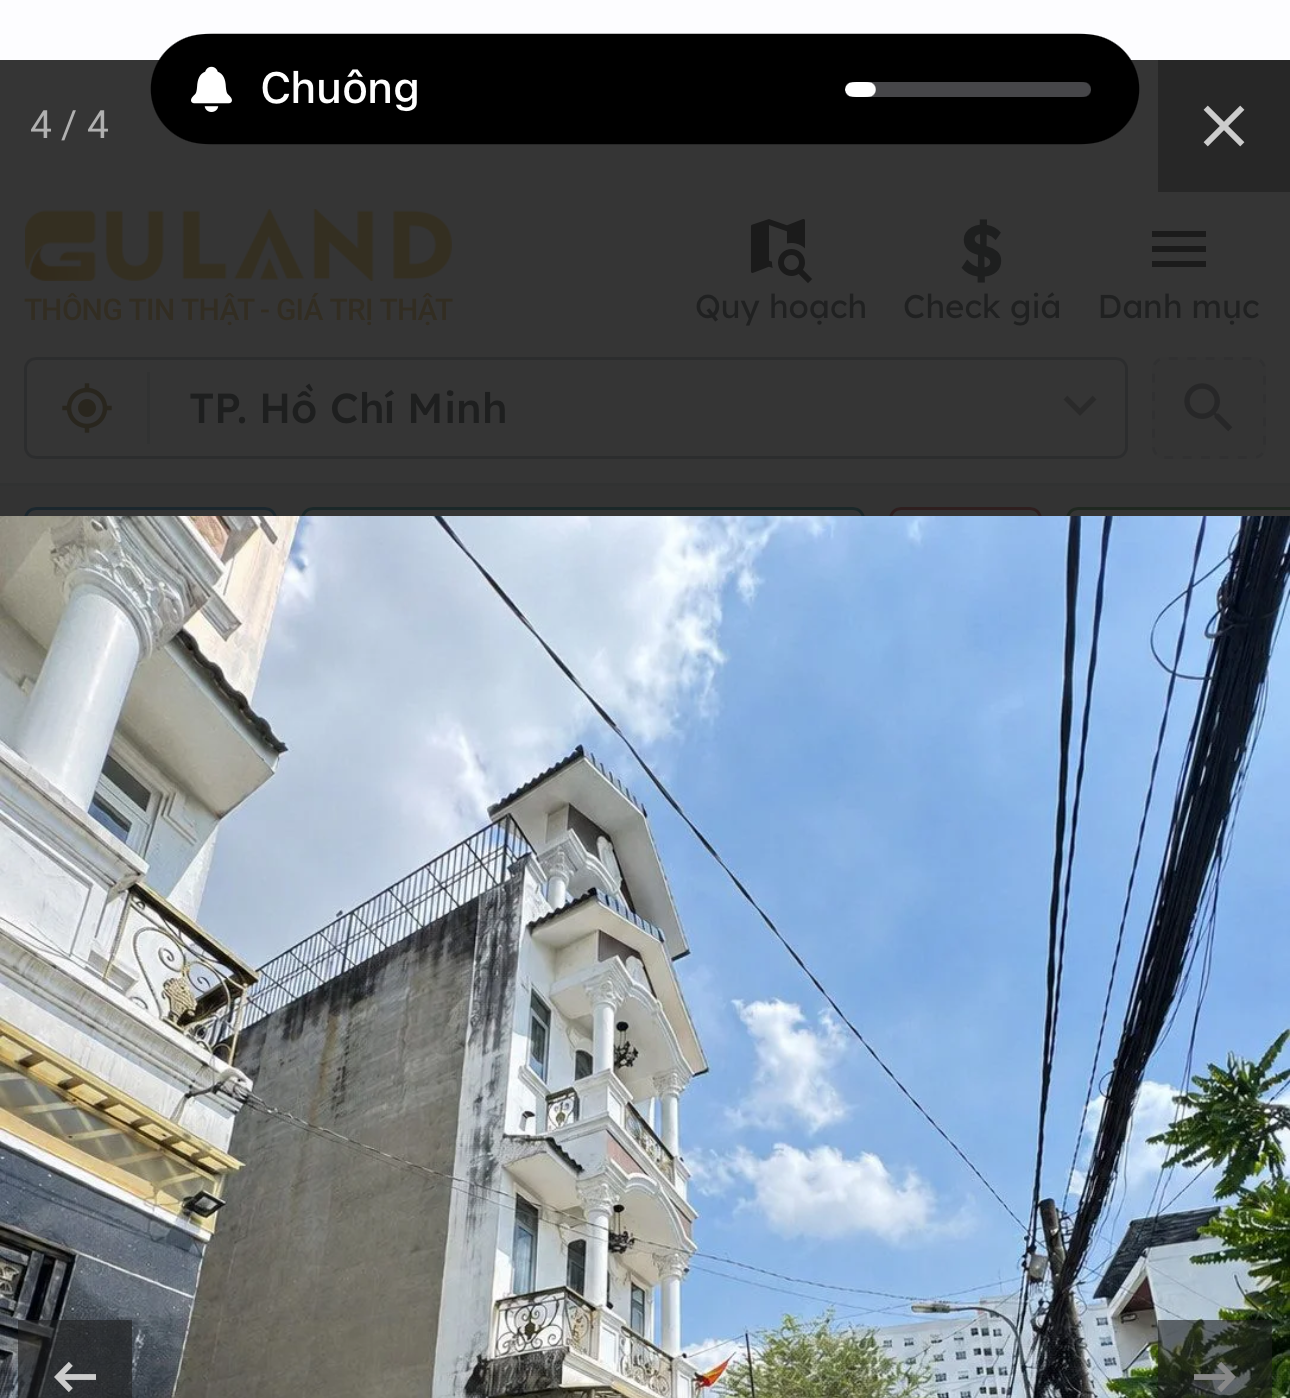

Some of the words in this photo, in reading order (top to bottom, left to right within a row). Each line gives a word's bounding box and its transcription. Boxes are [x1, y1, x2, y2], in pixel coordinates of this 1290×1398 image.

[262, 69, 417, 111] Chuông
[31, 110, 51, 138] 4
[61, 110, 76, 141] /
[88, 110, 108, 138] 4
[25, 209, 452, 281] GULAND
[24, 293, 121, 320] THÔNG
[129, 298, 173, 320] TIN
[181, 293, 255, 325] THẬT
[277, 293, 323, 320] GIÁ
[330, 298, 371, 325] TRỊ
[380, 293, 453, 325] THẬT
[696, 294, 759, 326] Quy
[771, 293, 865, 325] hoạch
[904, 293, 1000, 318] Check
[1011, 292, 1059, 326] giá
[1101, 293, 1181, 318] Danh
[1194, 300, 1259, 325] mục
[190, 393, 245, 424] TP.
[263, 384, 316, 424] Hồ
[332, 390, 394, 424] Chí
[411, 390, 505, 423] Minh
